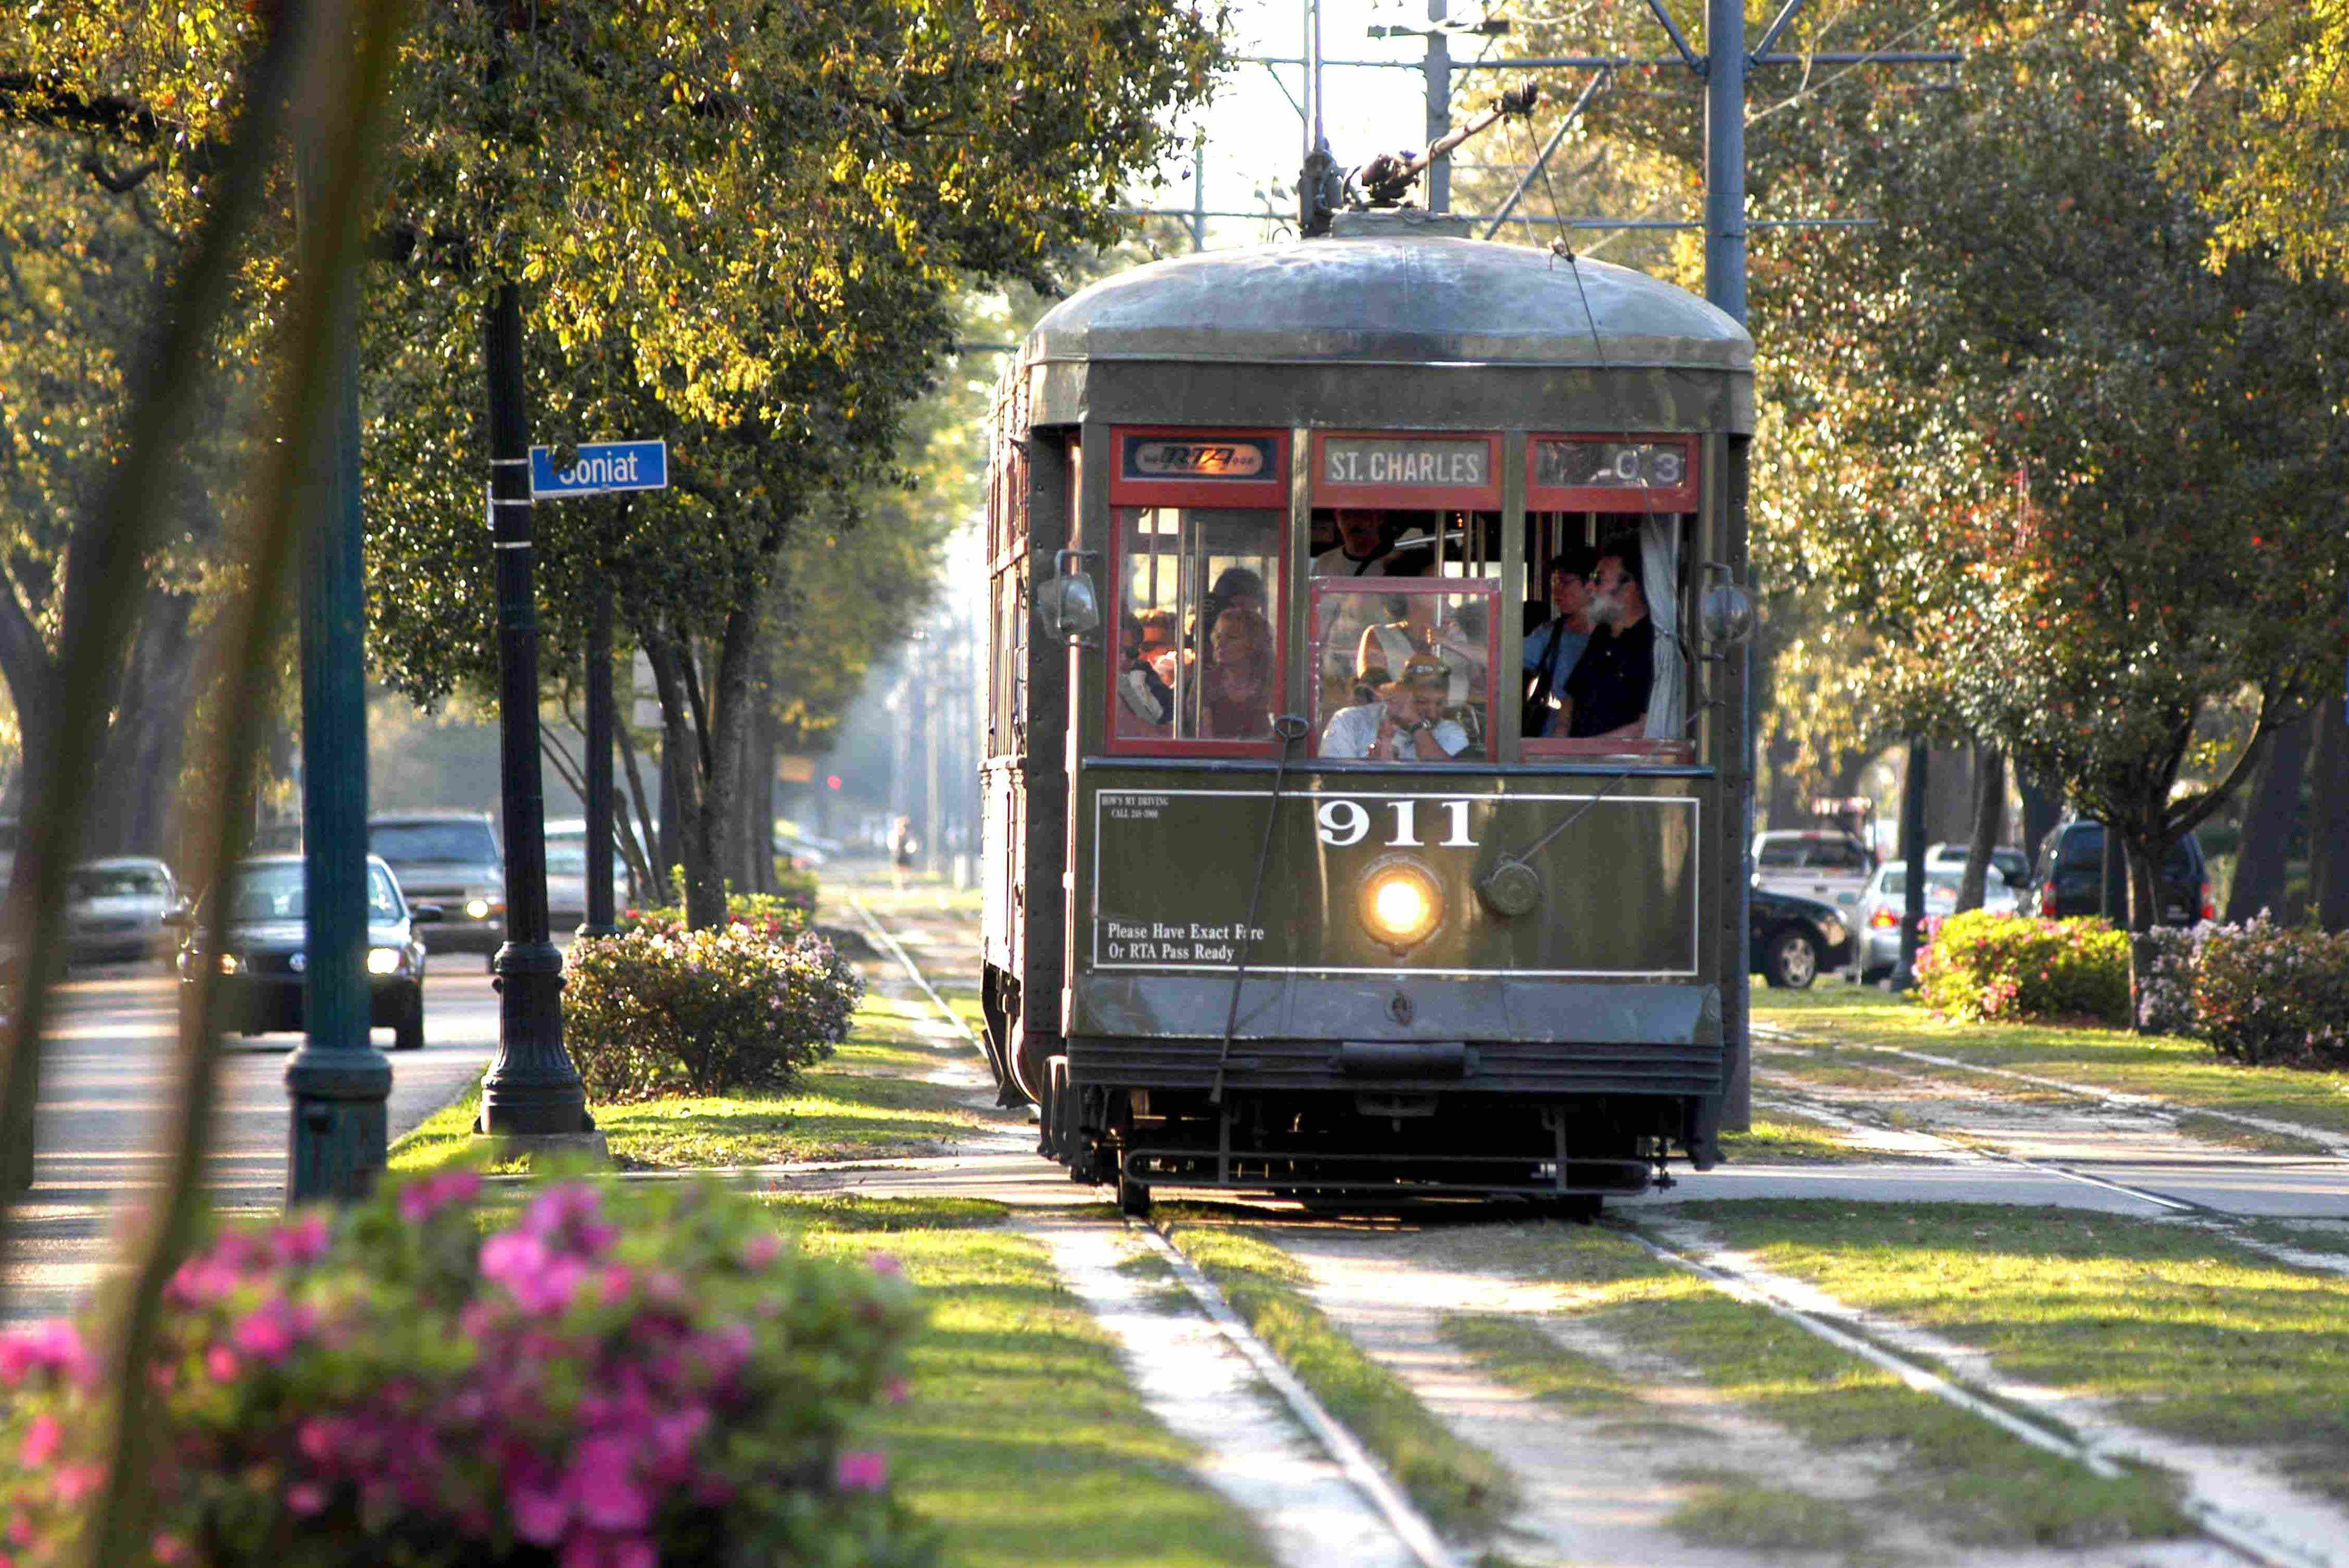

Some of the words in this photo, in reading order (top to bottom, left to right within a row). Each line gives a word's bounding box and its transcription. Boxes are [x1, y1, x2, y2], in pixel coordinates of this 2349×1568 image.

[1331, 451, 1364, 481] ST.
[1371, 451, 1480, 482] CHARLES
[1125, 796, 1136, 805] MY
[1111, 809, 1129, 818] CALL
[1318, 800, 1480, 847] 911
[1108, 923, 1147, 939] Please
[1153, 923, 1185, 939] Have
[1190, 924, 1229, 940] Exact
[1108, 943, 1125, 959] Or
[1130, 943, 1156, 959] RTA
[1162, 944, 1189, 960] Pass
[1195, 944, 1235, 962] Ready
